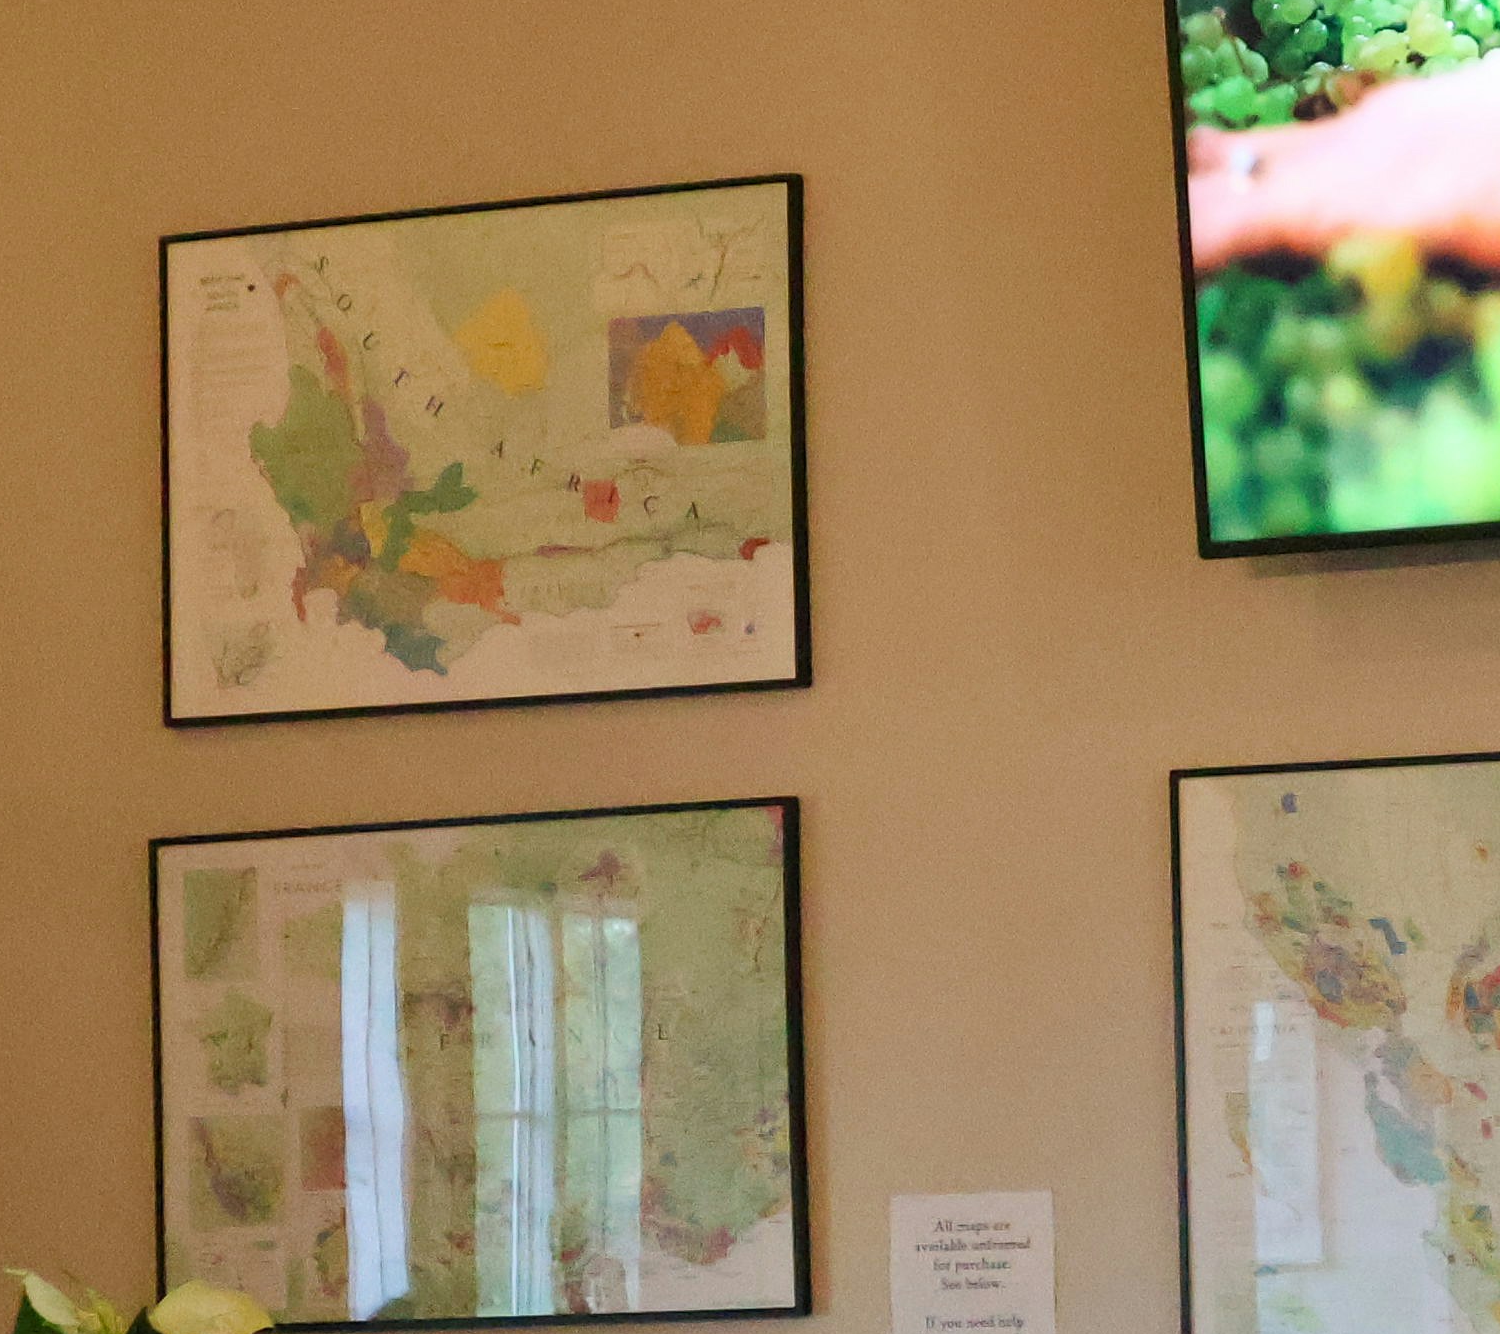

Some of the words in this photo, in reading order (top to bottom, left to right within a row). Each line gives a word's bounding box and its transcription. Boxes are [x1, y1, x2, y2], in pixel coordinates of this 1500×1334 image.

[314, 255, 445, 418] SOUTH
[490, 439, 702, 522] AFRICA
[940, 1318, 962, 1332] you
